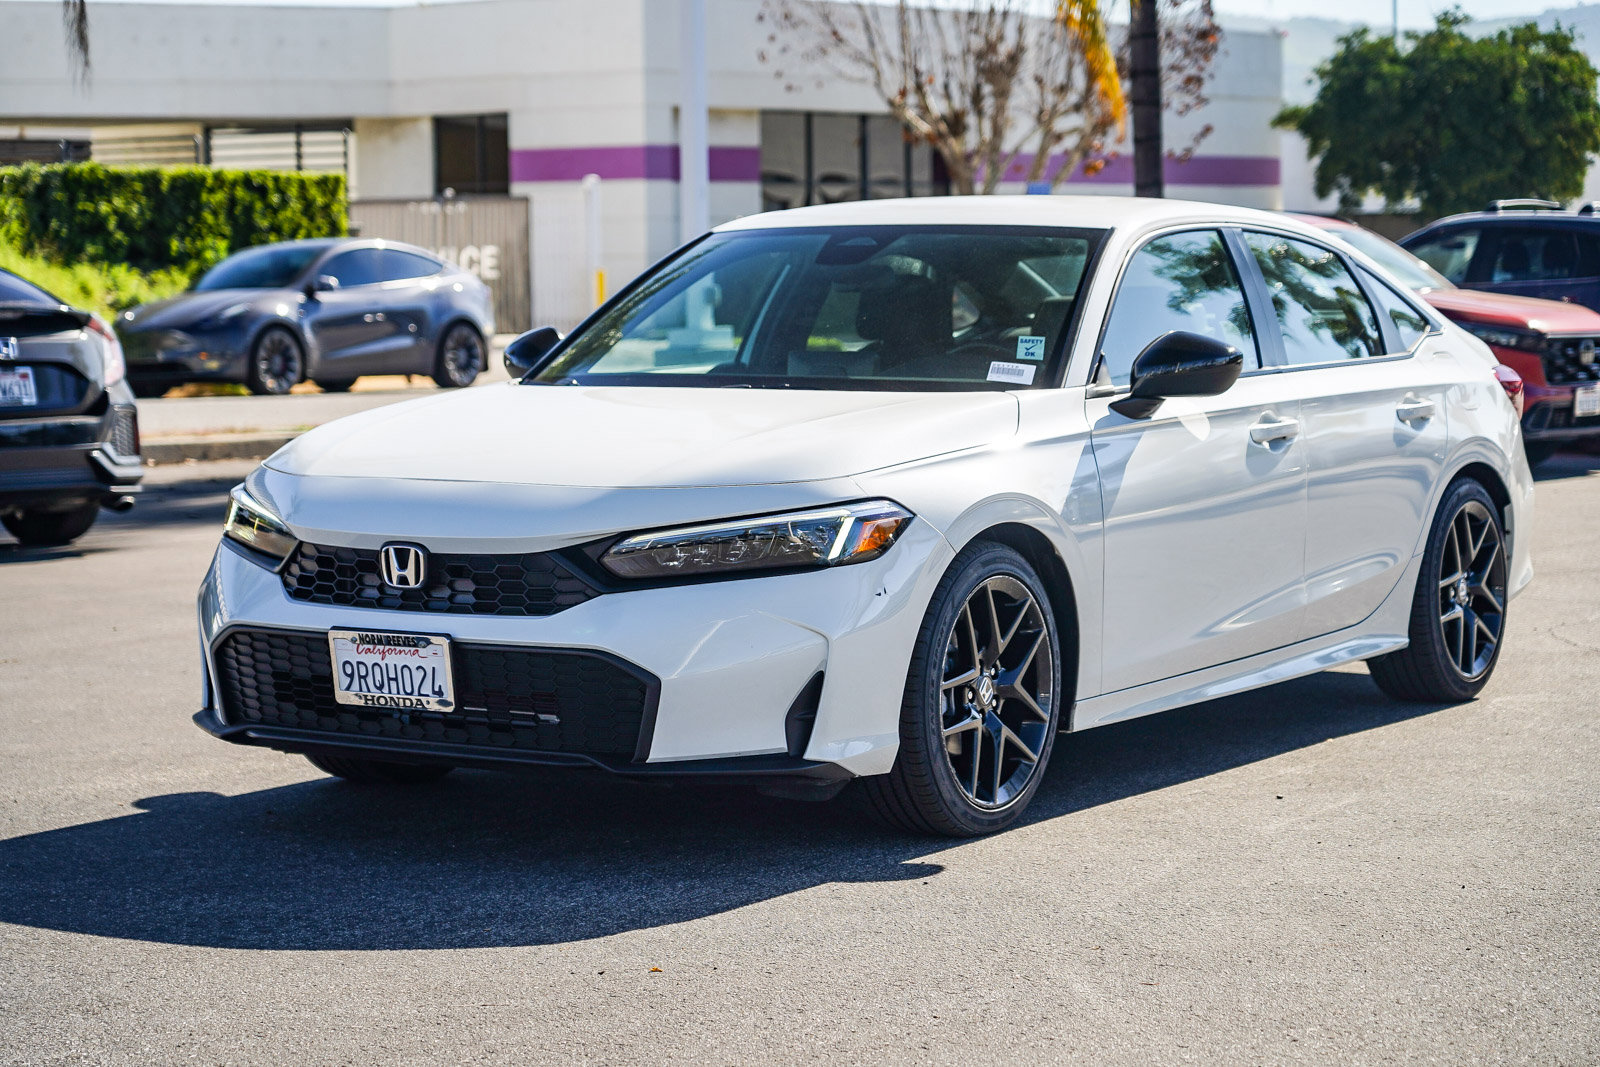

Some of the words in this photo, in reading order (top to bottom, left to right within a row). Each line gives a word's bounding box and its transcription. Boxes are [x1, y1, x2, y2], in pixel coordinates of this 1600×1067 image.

[358, 633, 384, 646] NORM
[386, 635, 417, 647] REEVES
[356, 644, 428, 660] California
[342, 660, 444, 698] 9RQH024
[363, 695, 426, 709] HONDA
